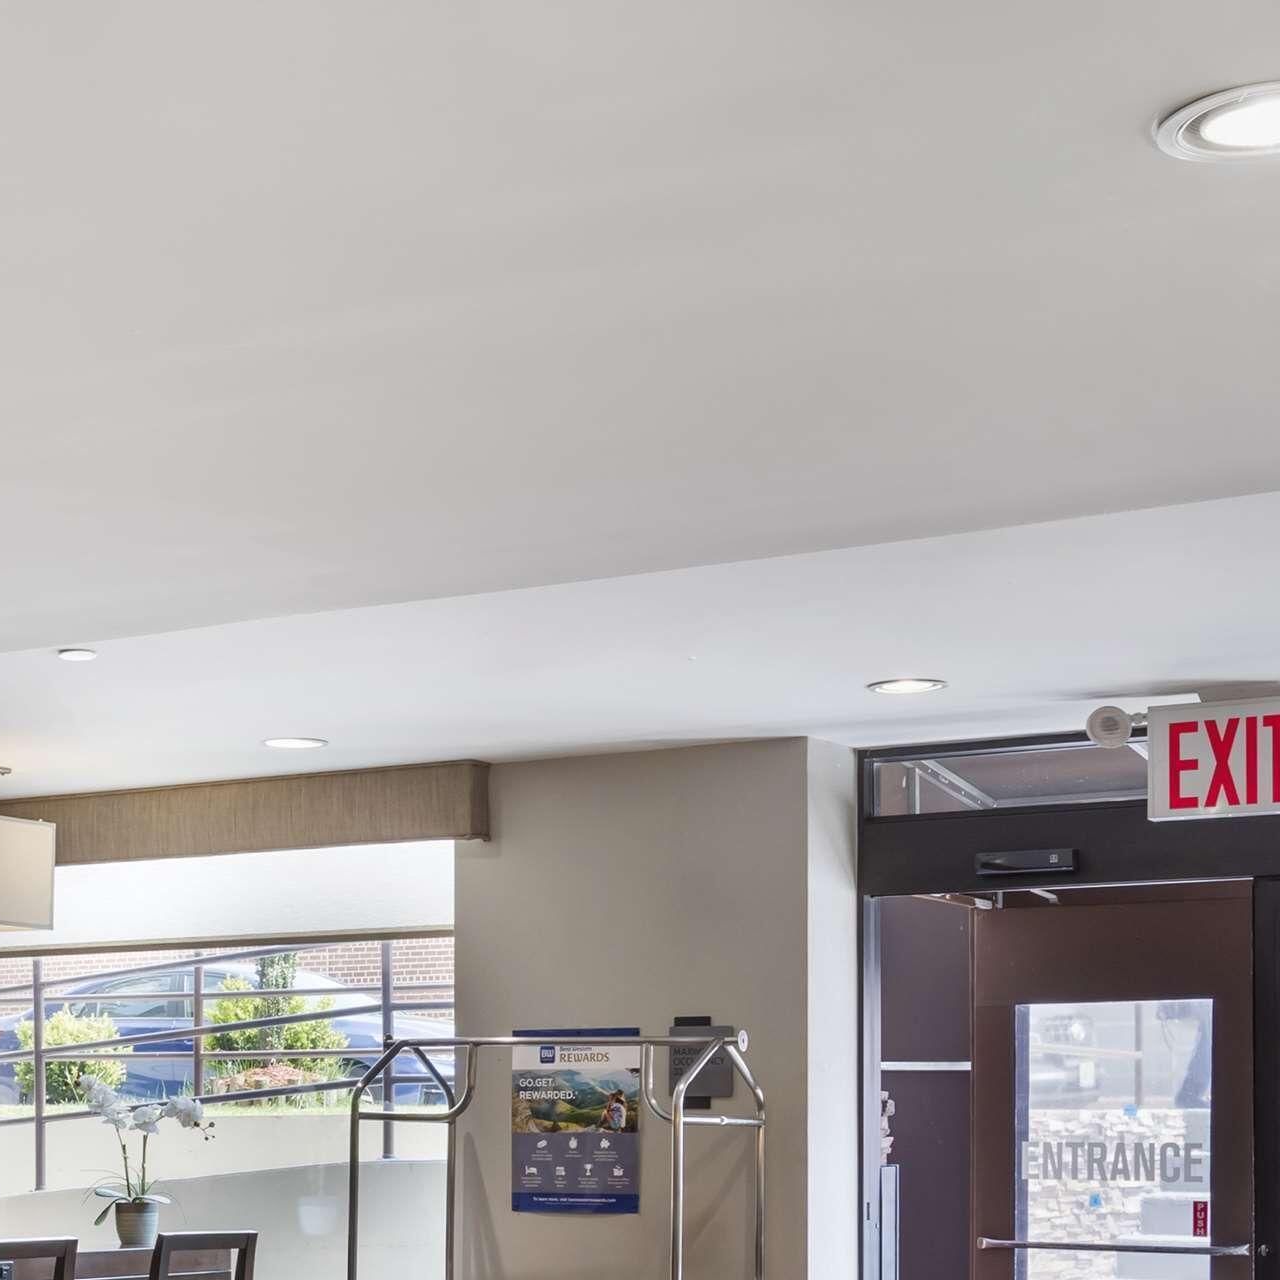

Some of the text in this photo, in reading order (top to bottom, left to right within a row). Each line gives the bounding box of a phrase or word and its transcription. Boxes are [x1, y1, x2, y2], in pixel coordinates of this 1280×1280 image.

[560, 1052, 609, 1062] REWARDS
[1022, 1141, 1204, 1183] ENTRANCE
[1197, 1202, 1205, 1235] PUSH
